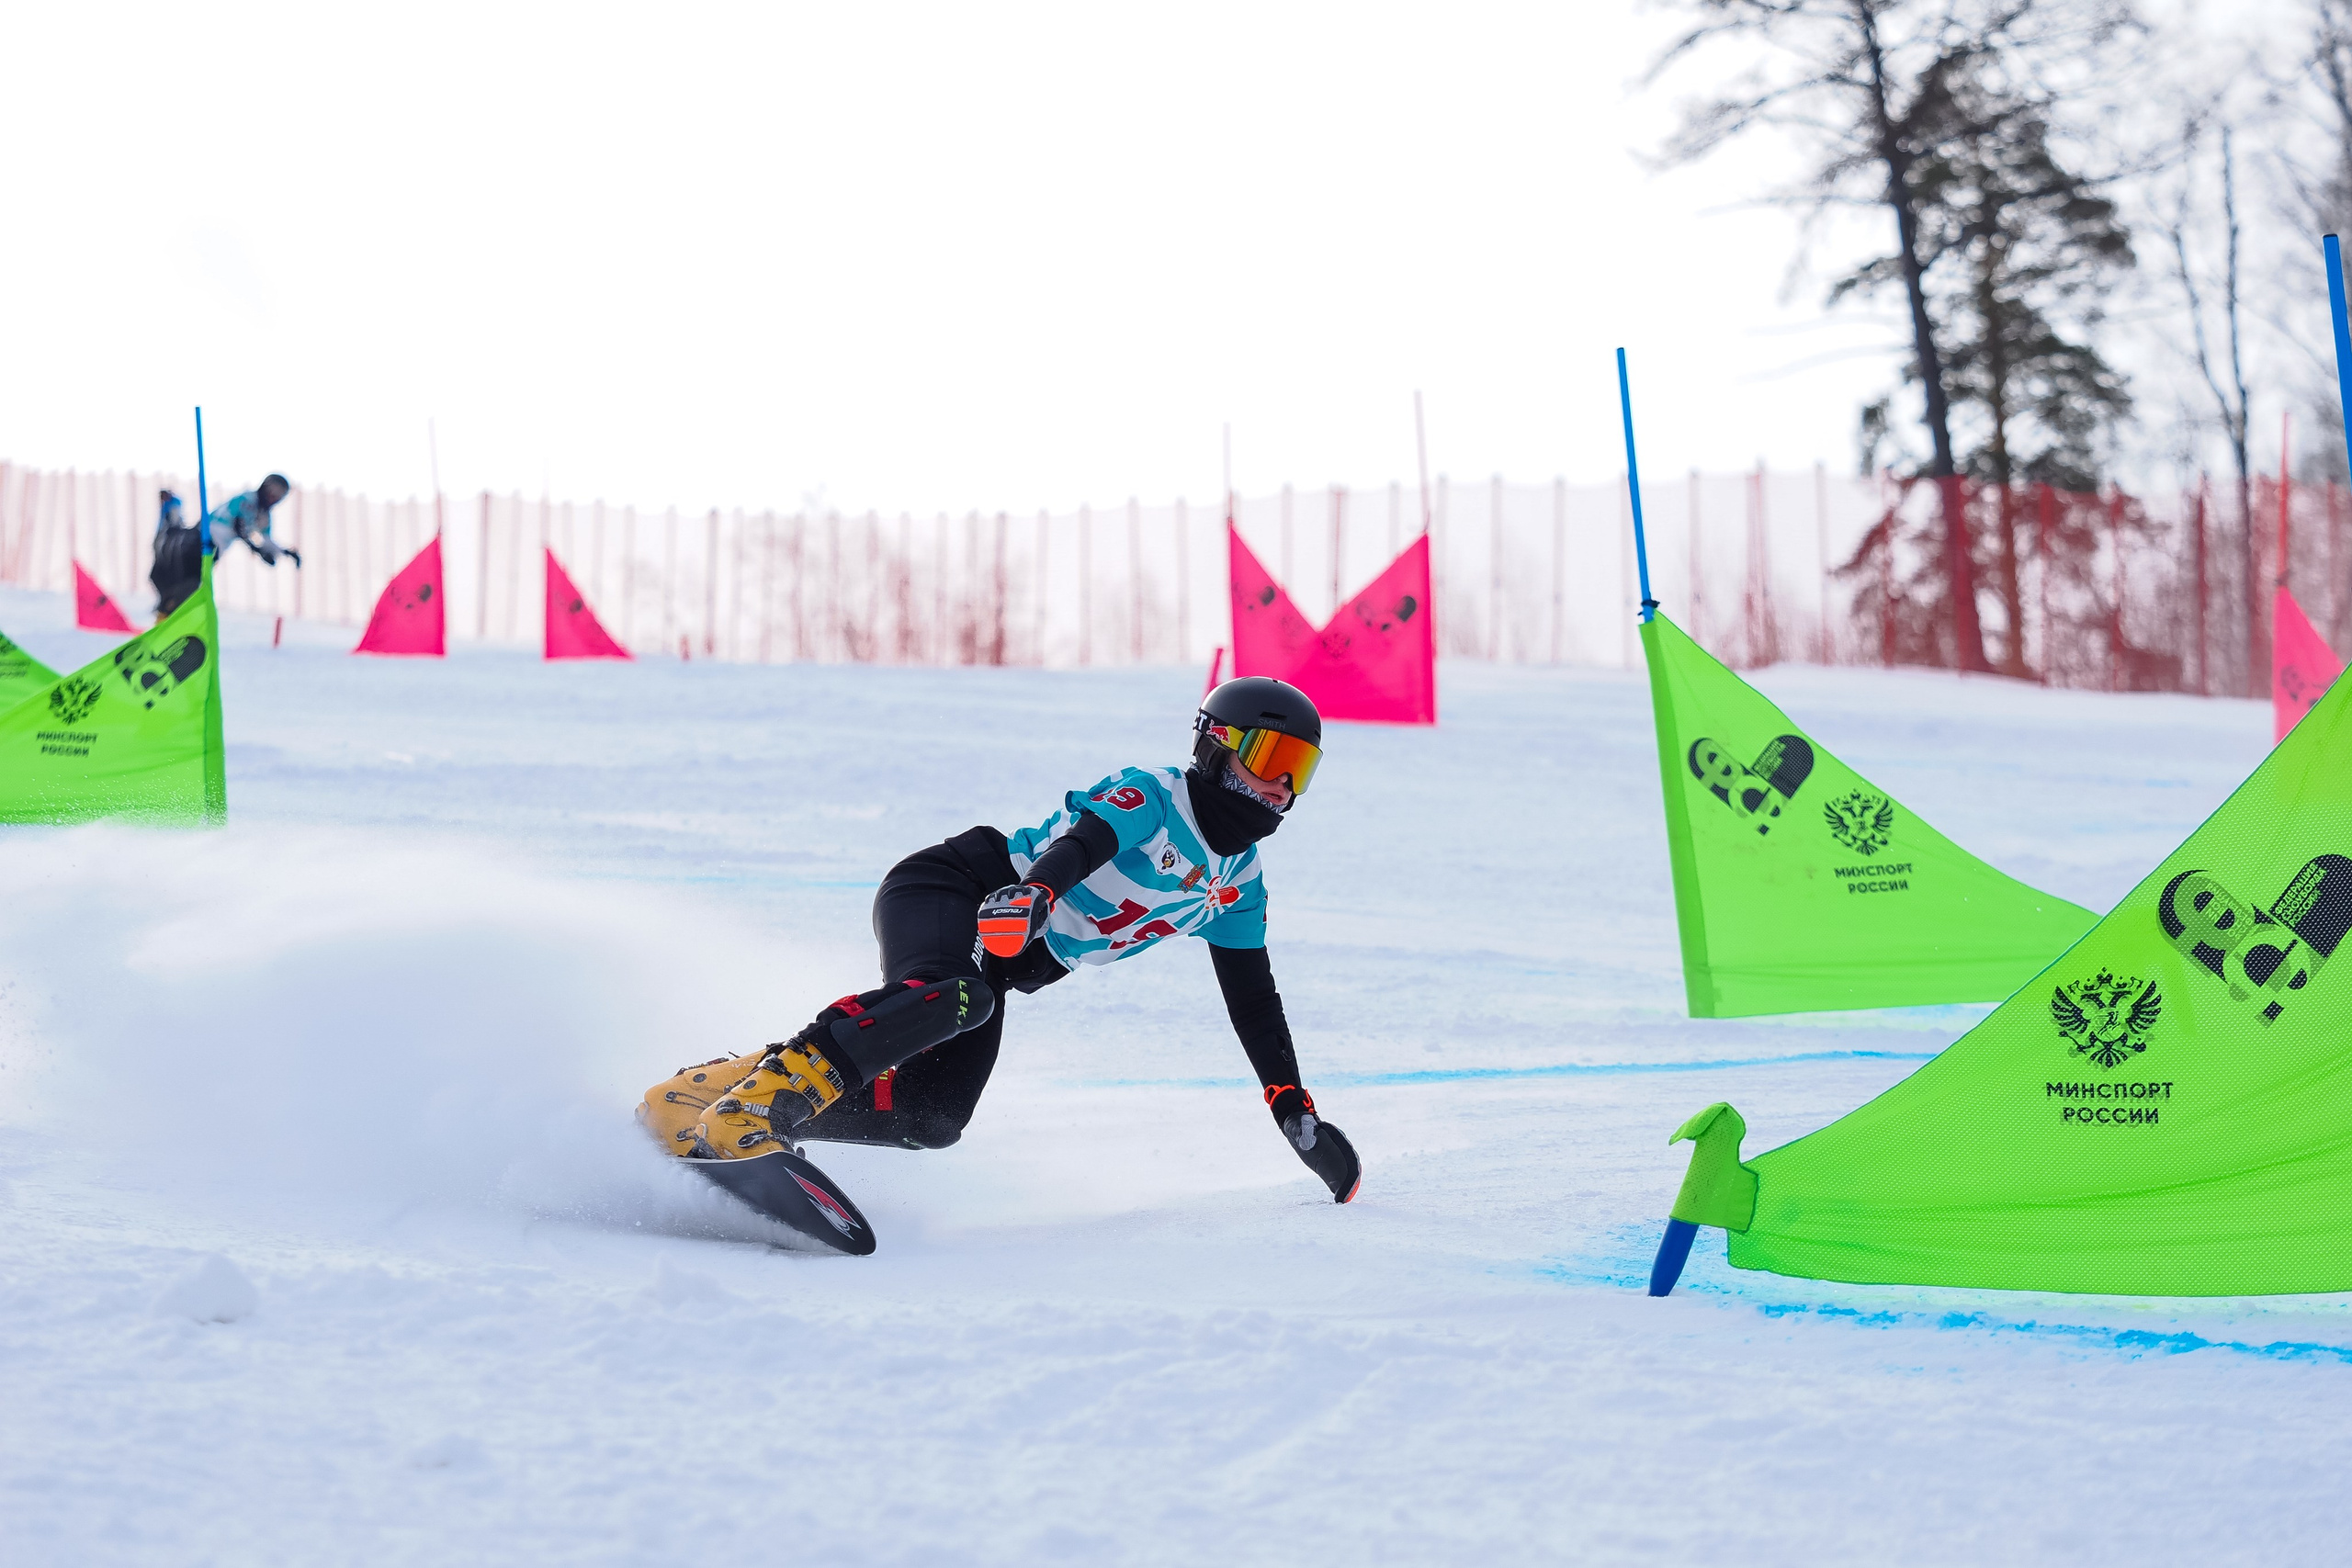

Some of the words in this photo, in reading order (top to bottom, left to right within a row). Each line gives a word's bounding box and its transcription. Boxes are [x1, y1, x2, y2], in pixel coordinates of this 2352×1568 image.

[1258, 718, 1286, 730] SMITH
[36, 731, 98, 744] МИНСПОРТ
[41, 744, 89, 758] РОССИИ
[1834, 863, 1913, 878] МИНСПОРТ
[1848, 879, 1909, 894] РОССИИ
[2274, 863, 2319, 915] ФЕДЕРАЦИЯ
[2281, 868, 2328, 921] СНОУБОРДА
[2289, 889, 2323, 928] РОССИИ
[1088, 897, 1178, 950] 19
[2045, 1082, 2174, 1099] МИНСПОРТ
[2063, 1107, 2159, 1124] РОССИИ
